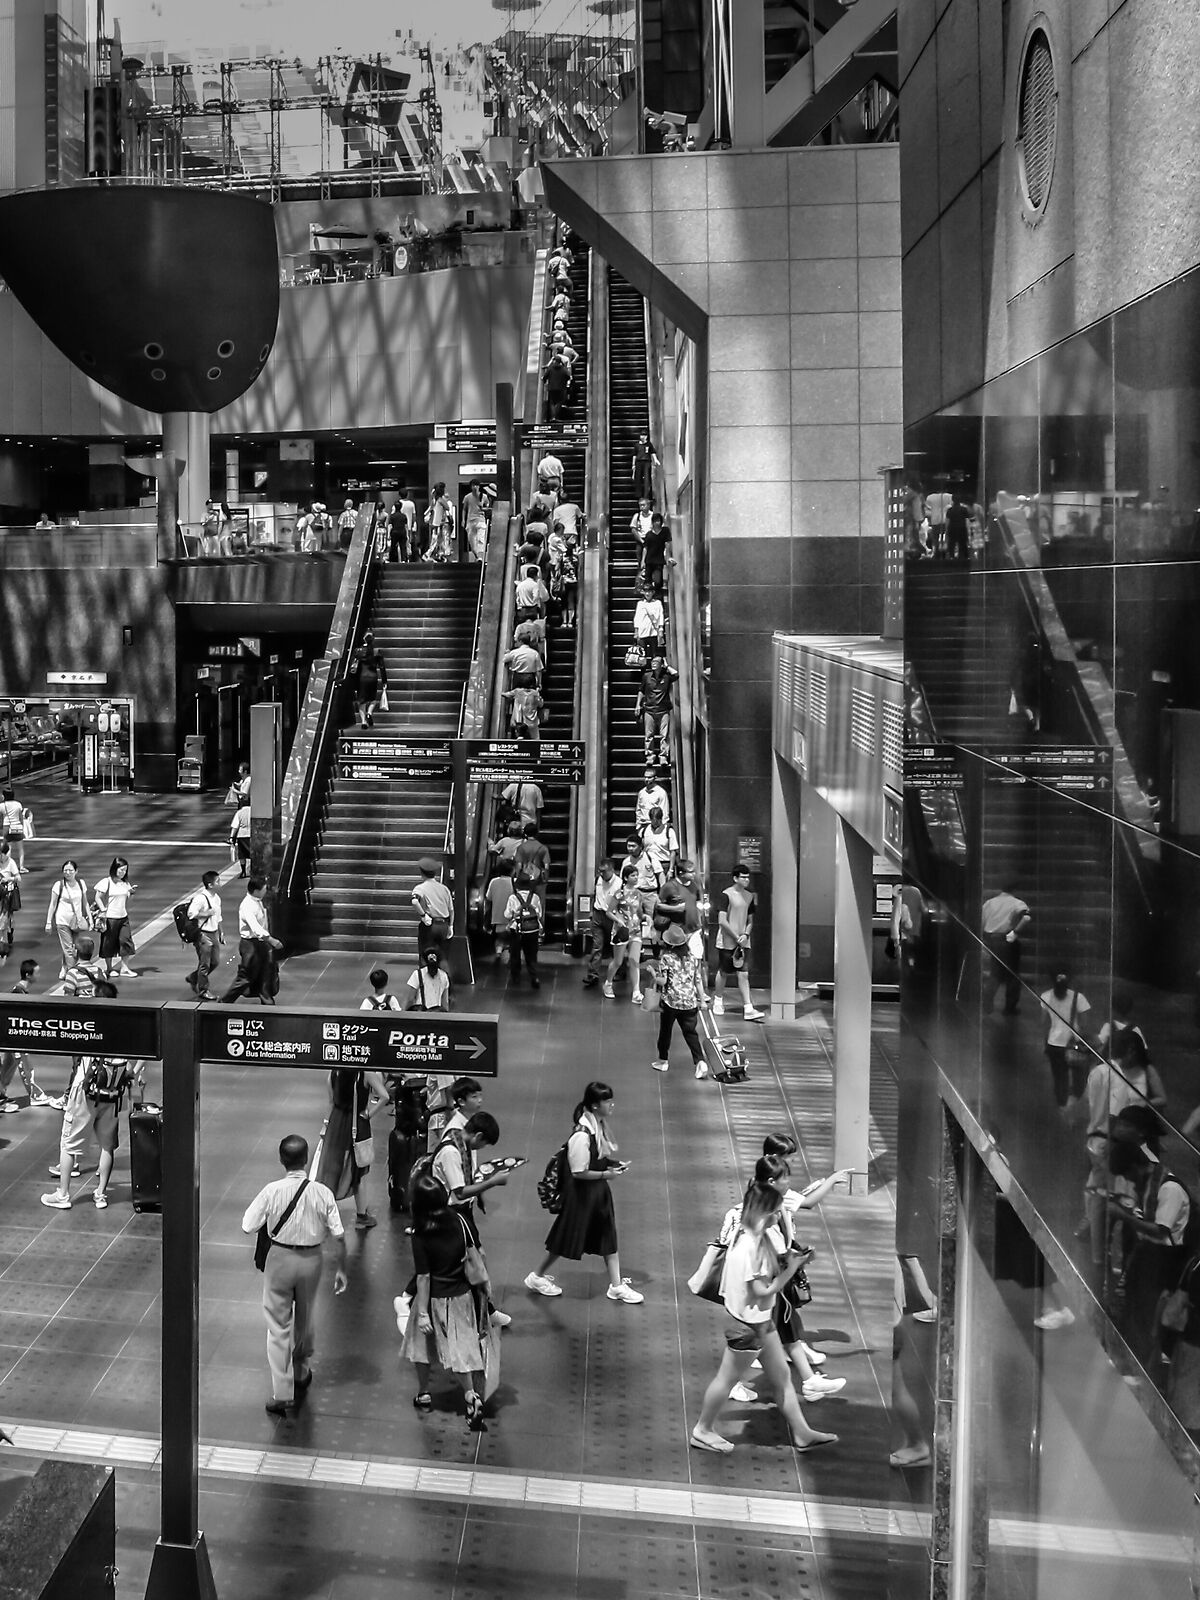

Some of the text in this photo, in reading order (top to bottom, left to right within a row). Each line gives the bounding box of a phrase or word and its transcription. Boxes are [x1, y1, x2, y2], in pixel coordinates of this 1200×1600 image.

[246, 1019, 265, 1030] バス
[342, 1024, 379, 1034] タクシー
[60, 1031, 89, 1041] Shopping
[246, 1029, 259, 1037] Bus
[388, 1030, 449, 1047] Porta
[246, 1041, 311, 1054] バス総合案内所
[342, 1045, 371, 1057] 地下鉄
[342, 1055, 369, 1063] Subway
[396, 1051, 443, 1062] Shopping Mall
